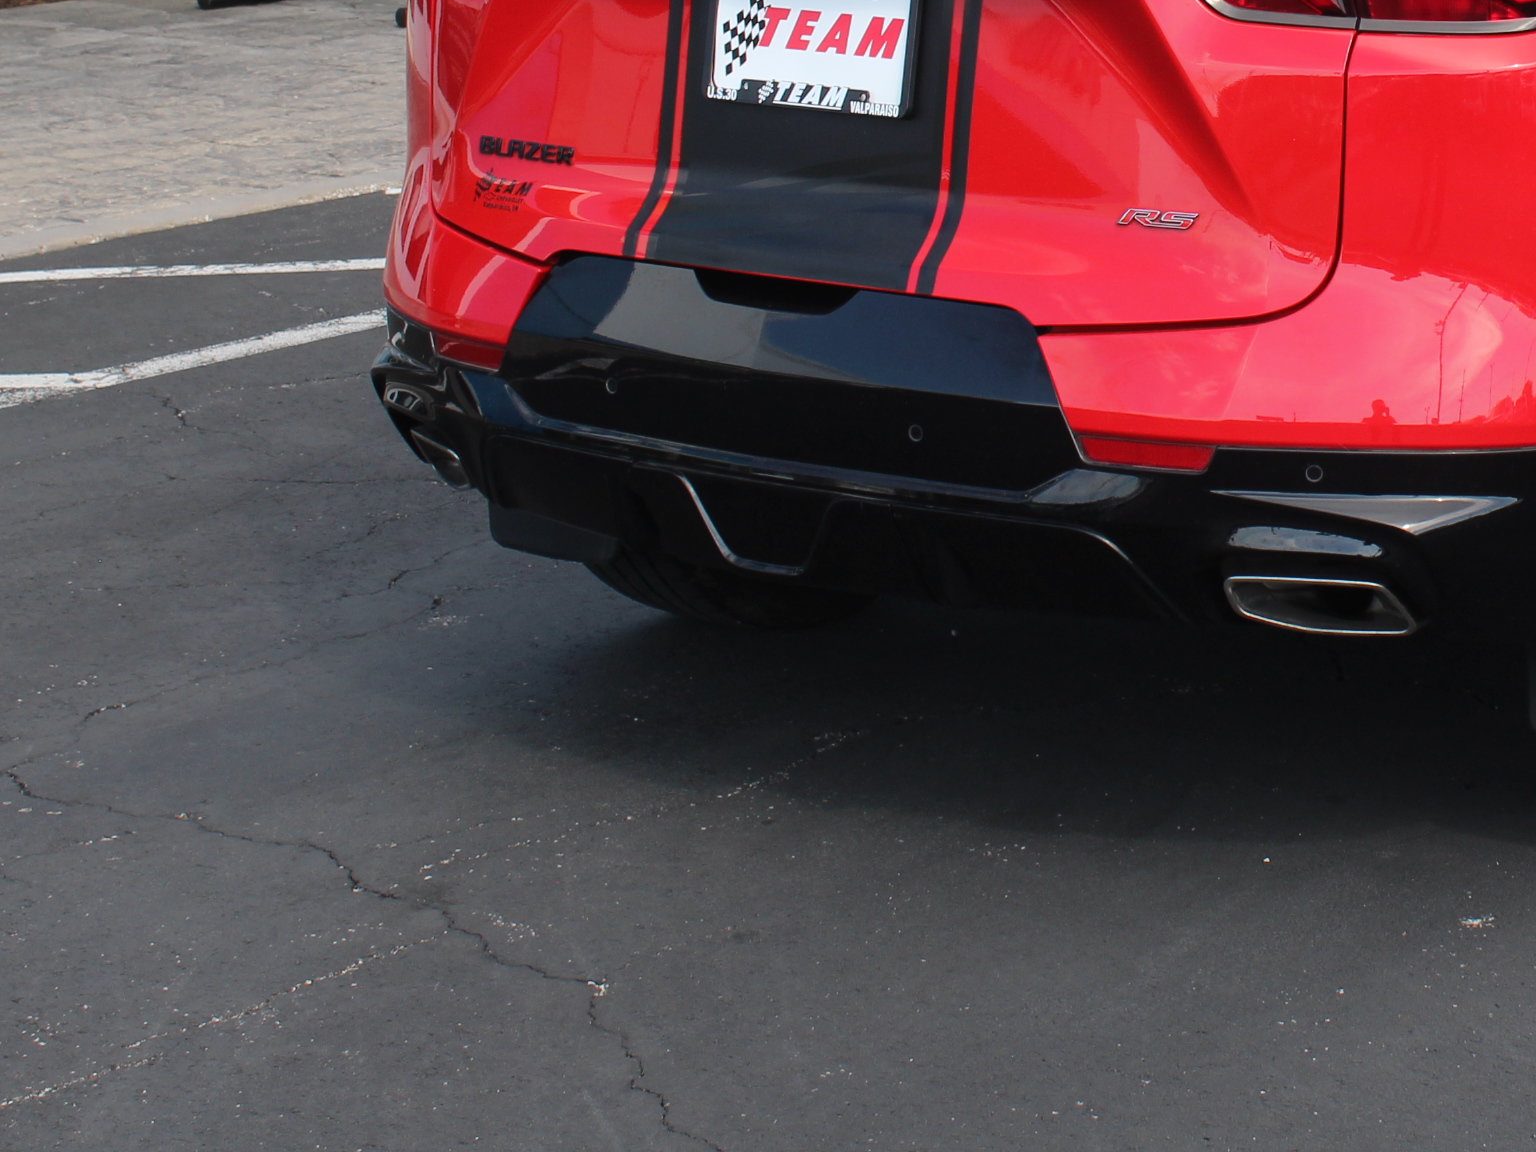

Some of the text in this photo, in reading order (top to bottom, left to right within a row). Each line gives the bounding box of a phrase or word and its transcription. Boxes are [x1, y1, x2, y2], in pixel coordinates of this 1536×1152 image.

[758, 6, 905, 60] TEAM
[773, 81, 850, 109] TEAM
[850, 100, 899, 118] VALPARAISO
[479, 135, 575, 166] BLAZER
[1117, 208, 1200, 230] RS
